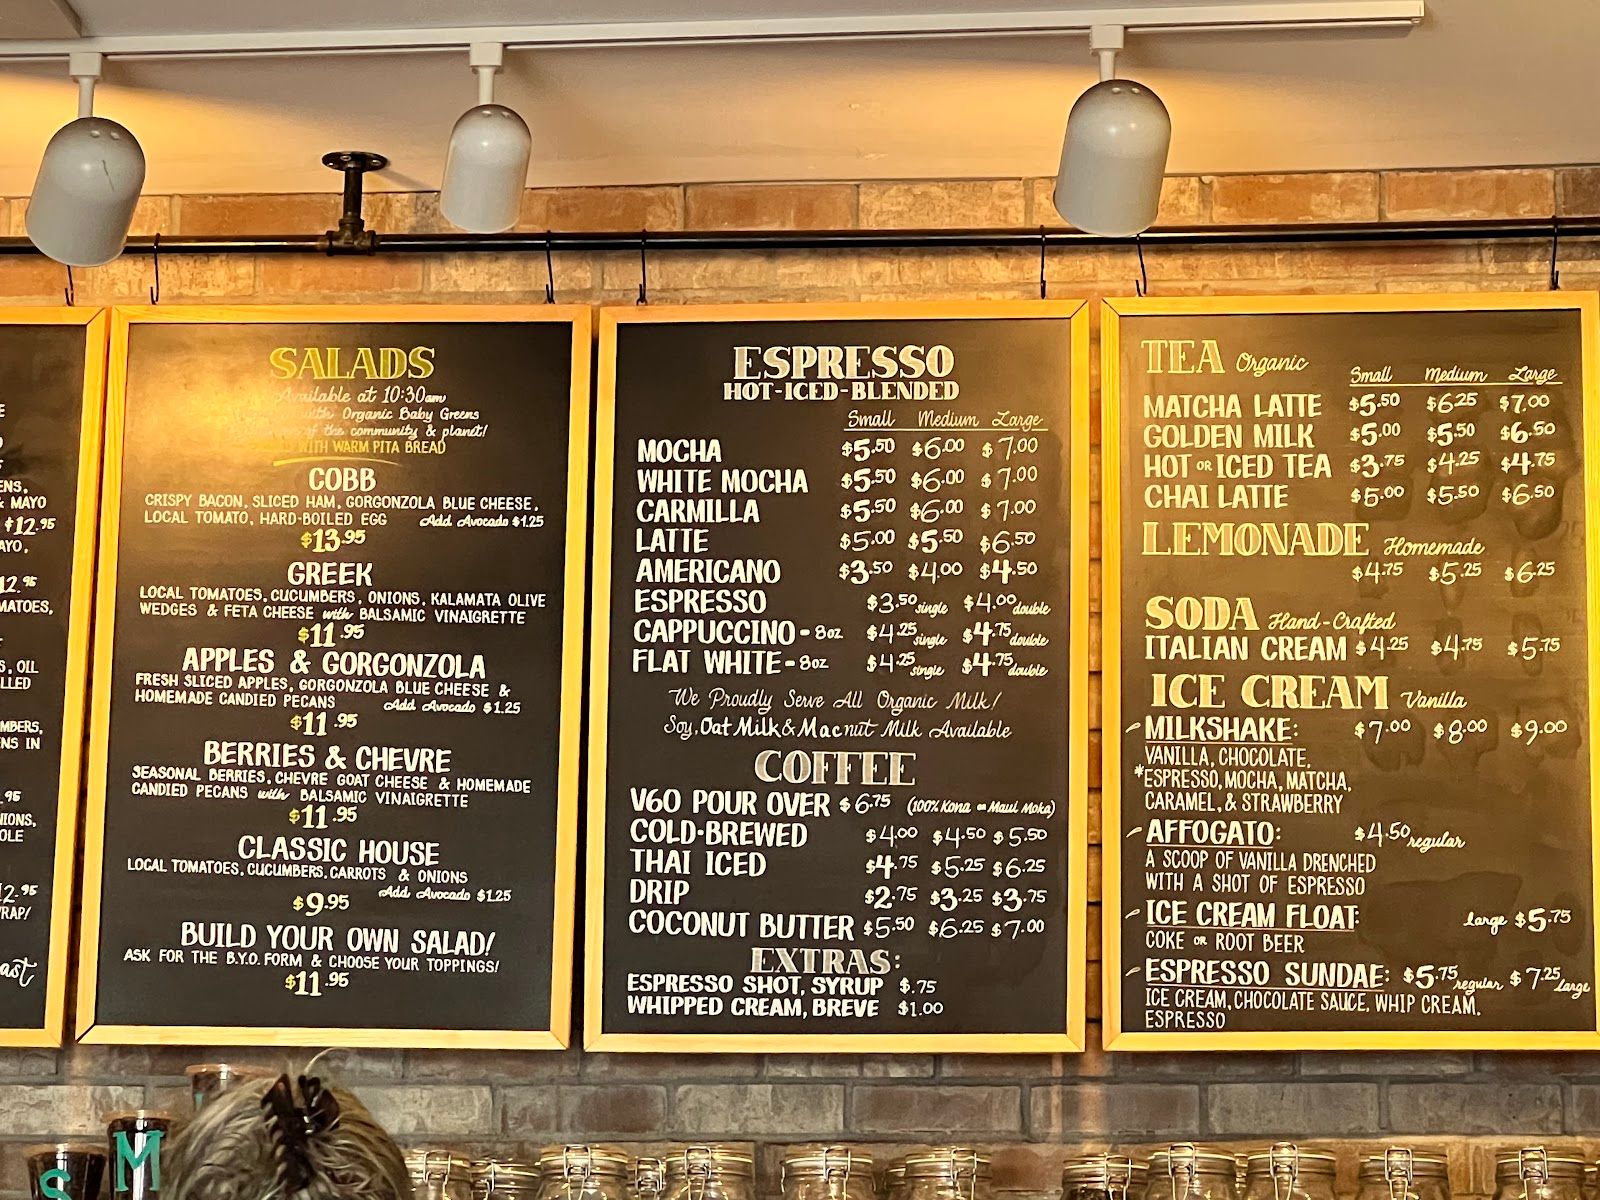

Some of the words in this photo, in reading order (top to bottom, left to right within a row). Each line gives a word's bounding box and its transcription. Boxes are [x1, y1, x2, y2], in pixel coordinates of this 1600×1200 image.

[270, 346, 435, 379] SALADS
[733, 345, 954, 379] ESPRESSO
[1141, 340, 1225, 373] TEA
[1236, 352, 1309, 377] Organic
[1350, 366, 1393, 383] Small
[1424, 366, 1488, 383] Medium
[1507, 365, 1558, 382] Large
[1144, 394, 1241, 418] MATCHA
[1254, 394, 1322, 417] LATTE
[1349, 393, 1400, 416] $5.50
[1427, 392, 1478, 413] $6.25
[1500, 394, 1550, 413] $7.00
[848, 410, 896, 427] Small
[917, 409, 980, 427] Medium
[991, 412, 1044, 430] Large
[1144, 424, 1242, 448] GOLDEN
[1254, 424, 1315, 448] MILK
[638, 439, 722, 463] MOCHA
[842, 438, 895, 461] $5.50
[912, 437, 964, 459] $6.00
[982, 436, 1038, 460] $7.00
[1145, 454, 1192, 478] HOT
[1197, 460, 1212, 471] OR
[1215, 454, 1273, 478] ICED
[1282, 454, 1332, 478] TEA
[309, 468, 376, 491] COBB
[637, 469, 711, 493] WHITE
[722, 469, 808, 493] MOCHA
[11, 496, 46, 509] MAYO
[145, 494, 192, 506] CRISPY
[252, 495, 299, 508] SLICED
[346, 495, 435, 509] GORGONZOLA
[443, 496, 475, 510] BLUE
[1145, 485, 1209, 508] CHAI
[1218, 485, 1288, 509] LATTE
[145, 510, 188, 523] LOCAL
[260, 512, 352, 525] HARD-BOILED
[361, 513, 387, 525] EGG
[420, 514, 452, 527] Add
[457, 514, 509, 527] Avocado
[512, 515, 544, 528] $1.25
[637, 499, 760, 523] CARMILLA
[4, 516, 56, 535] $12.95
[301, 529, 365, 552] $13.95
[636, 528, 709, 553] LATTE
[840, 529, 895, 551] $5.00
[908, 529, 963, 553] $5.50
[980, 531, 1035, 555] $6.50
[1142, 522, 1369, 556] LEMONADE
[1384, 537, 1485, 556] Homemade
[288, 562, 372, 586] GREEK
[636, 558, 780, 583] AMERICANO
[140, 585, 184, 599] LOCAL
[431, 592, 501, 606] KALAMATA
[508, 593, 546, 607] OLIVE
[635, 589, 766, 614] ESPRESSO
[140, 602, 197, 616] WEDGES
[207, 604, 218, 616] &
[224, 604, 258, 618] FETA
[263, 605, 314, 619] CHEESE
[323, 607, 354, 620] with
[360, 608, 425, 622] BALSAMIC
[434, 609, 526, 624] VINAIGRETTE
[1145, 596, 1260, 630] SODA
[1268, 612, 1396, 635] Hand-Crafted
[298, 622, 364, 647] $11.95
[634, 619, 795, 645] CAPPUCCINO
[1145, 635, 1248, 660] ITALIAN
[1261, 636, 1346, 661] CREAM
[17, 660, 39, 673] OIL
[182, 647, 274, 673] APPLES
[290, 649, 311, 674] &
[322, 651, 485, 679] GORGONZOLA
[633, 649, 691, 673] FLAT
[704, 650, 782, 674] WHITE
[668, 687, 700, 706] We
[709, 688, 773, 715] Proudly
[784, 689, 825, 708] Serve
[833, 690, 863, 708] All
[877, 690, 938, 716] Organic
[1151, 674, 1225, 708] ICE
[1241, 675, 1388, 709] CREAM
[1400, 690, 1467, 708] Vanilla
[1145, 715, 1298, 741] MILKSHAKE:
[26, 737, 40, 749] IN
[204, 741, 315, 767] BERRIES
[325, 745, 347, 769] &
[356, 746, 451, 773] CHEVRE
[755, 750, 916, 785] COFFEE
[630, 787, 681, 813] V60
[693, 790, 757, 815] POUR
[767, 792, 830, 817] OVER
[839, 793, 891, 814] $6.75
[1225, 793, 1237, 811] &
[1242, 793, 1343, 814] STRAWBERRY
[1146, 819, 1280, 845] AFFOGATO:
[238, 835, 347, 862] CLASSIC
[359, 839, 439, 866] HOUSE
[630, 849, 691, 874] THAI
[706, 851, 766, 877] ICED
[293, 892, 349, 916] $9.95
[630, 879, 689, 905] DRIP
[629, 909, 750, 937] COCONUT
[760, 913, 854, 941] BUTTER
[1146, 899, 1186, 926] ICE
[1196, 902, 1276, 928] CREAM
[1286, 904, 1359, 929] FLOAT:
[181, 922, 256, 948] BUILD
[267, 925, 333, 951] YOUR
[347, 927, 398, 953] OWN
[411, 930, 495, 956] SALAD!
[1146, 930, 1185, 949] COKE
[1194, 936, 1207, 945] OR
[1216, 933, 1255, 951] ROOT
[1263, 934, 1305, 953] BEER
[123, 948, 151, 962] ASK
[159, 949, 184, 963] FOR
[191, 950, 217, 964] THE
[227, 951, 260, 965] B.Y.O.
[264, 953, 302, 967] FORM
[311, 954, 322, 967] &
[329, 955, 379, 969] CHOOSE
[384, 957, 419, 971] YOUR
[426, 958, 499, 973] TOPPINGS!
[750, 947, 900, 974] EXTRAS:
[285, 971, 349, 996] $11.95
[628, 973, 733, 993] ESPRESSO
[811, 977, 883, 995] SYRUP
[900, 977, 937, 994] $.75
[1145, 958, 1270, 986] ESPRESSO
[1285, 962, 1390, 989] SUNDAE:
[627, 995, 723, 1015] WHIPPED
[812, 999, 879, 1017] BREVE
[898, 1000, 943, 1017] $1.00
[1145, 1010, 1225, 1029] ESPRESSO
